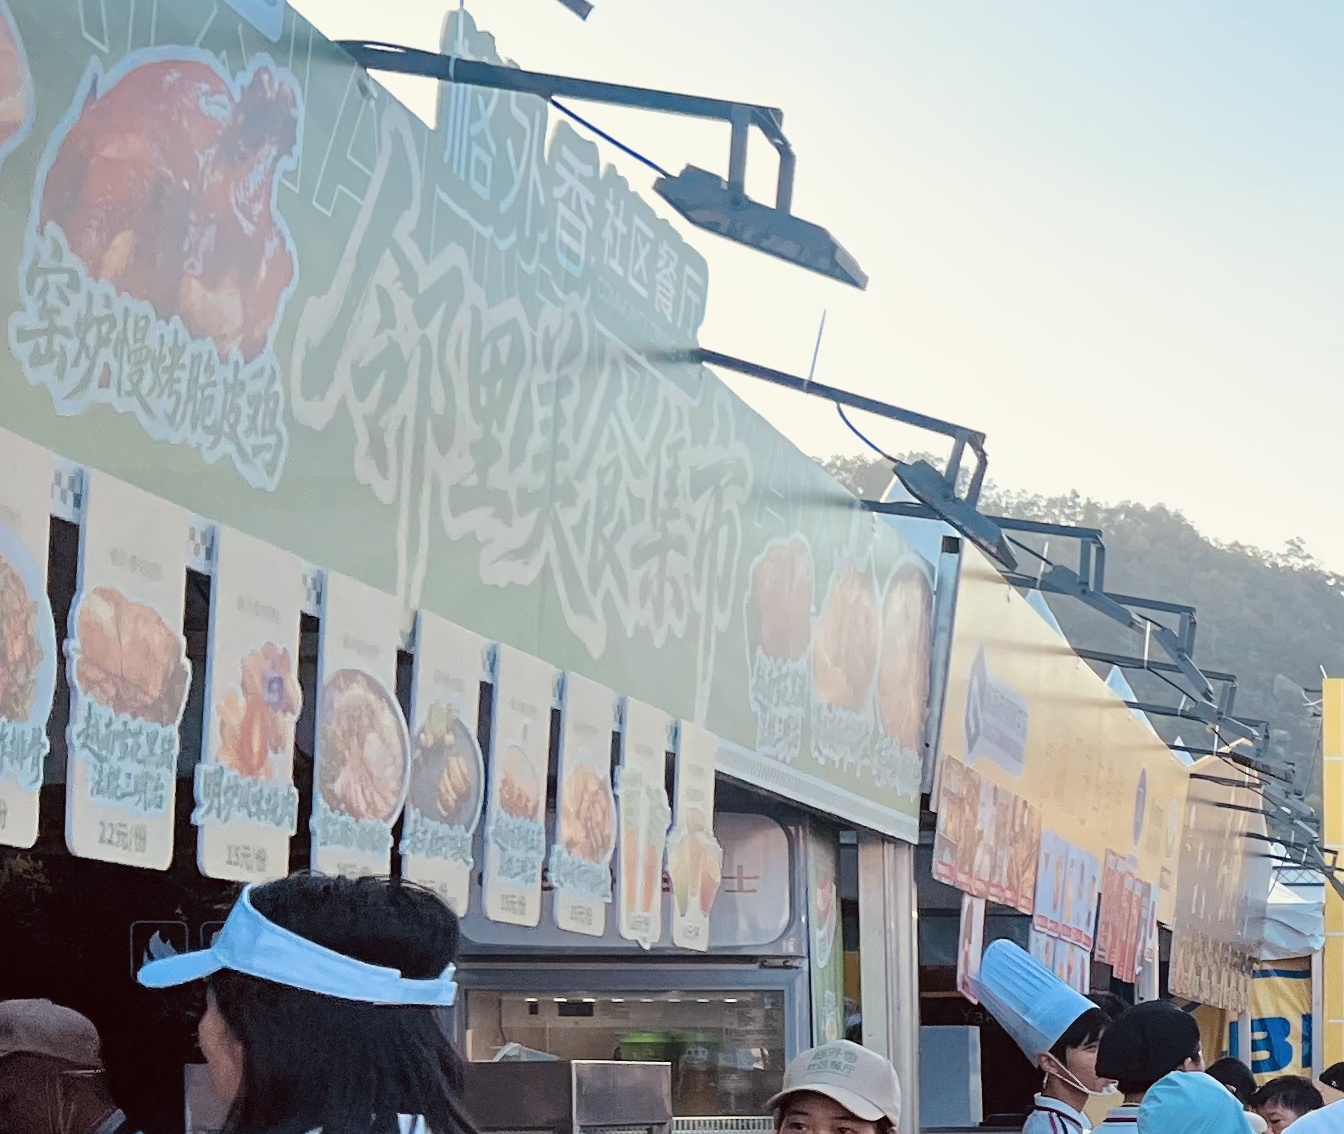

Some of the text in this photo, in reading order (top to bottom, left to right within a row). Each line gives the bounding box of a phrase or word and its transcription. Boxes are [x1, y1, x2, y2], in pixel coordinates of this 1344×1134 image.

[17, 236, 281, 478] 窑炉慢烤脆皮鸡
[601, 188, 704, 341] 社区餐厅
